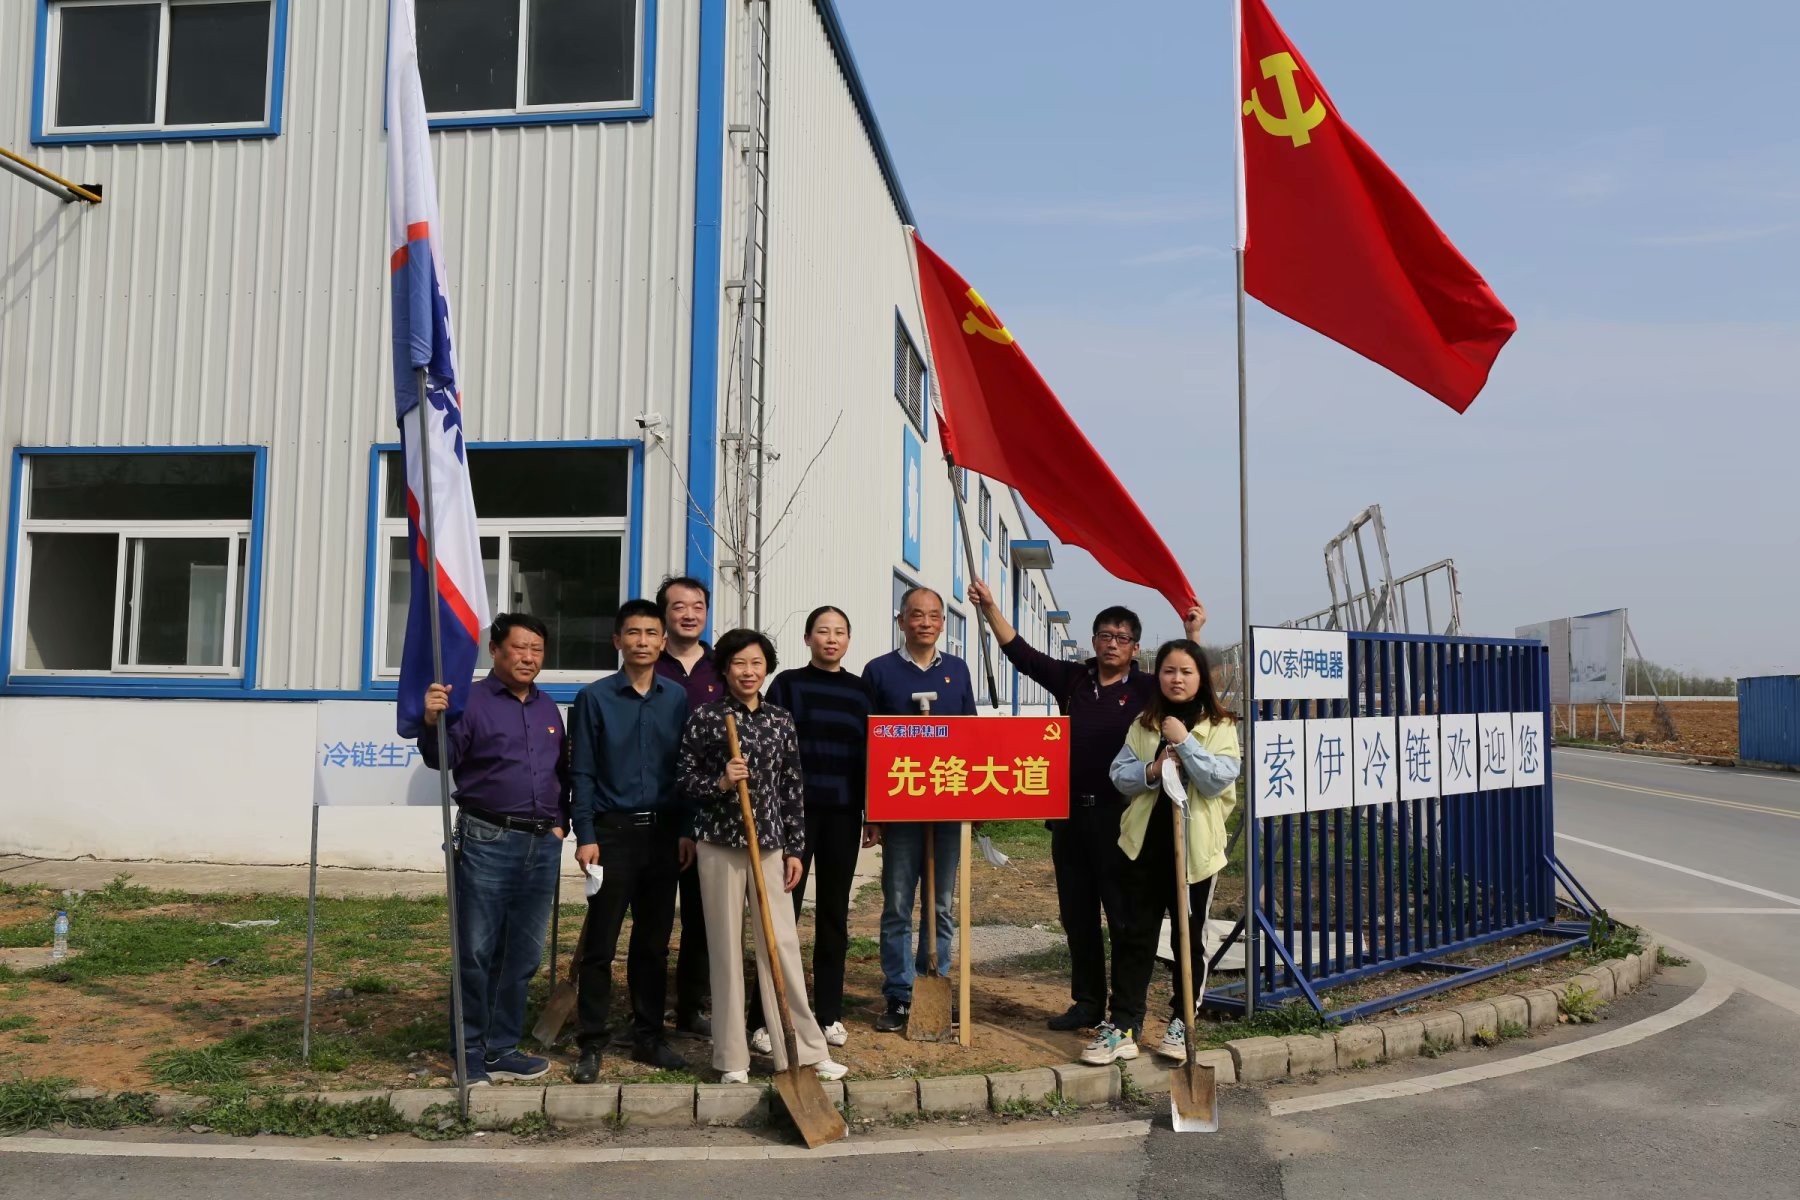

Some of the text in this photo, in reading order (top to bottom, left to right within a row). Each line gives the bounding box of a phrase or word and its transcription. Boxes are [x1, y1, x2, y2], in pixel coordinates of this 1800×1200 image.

[1259, 648, 1344, 680] OK索伊电器
[887, 755, 1051, 797] 先锋大道
[1263, 724, 1540, 800] 索伊冷链欢迎您
